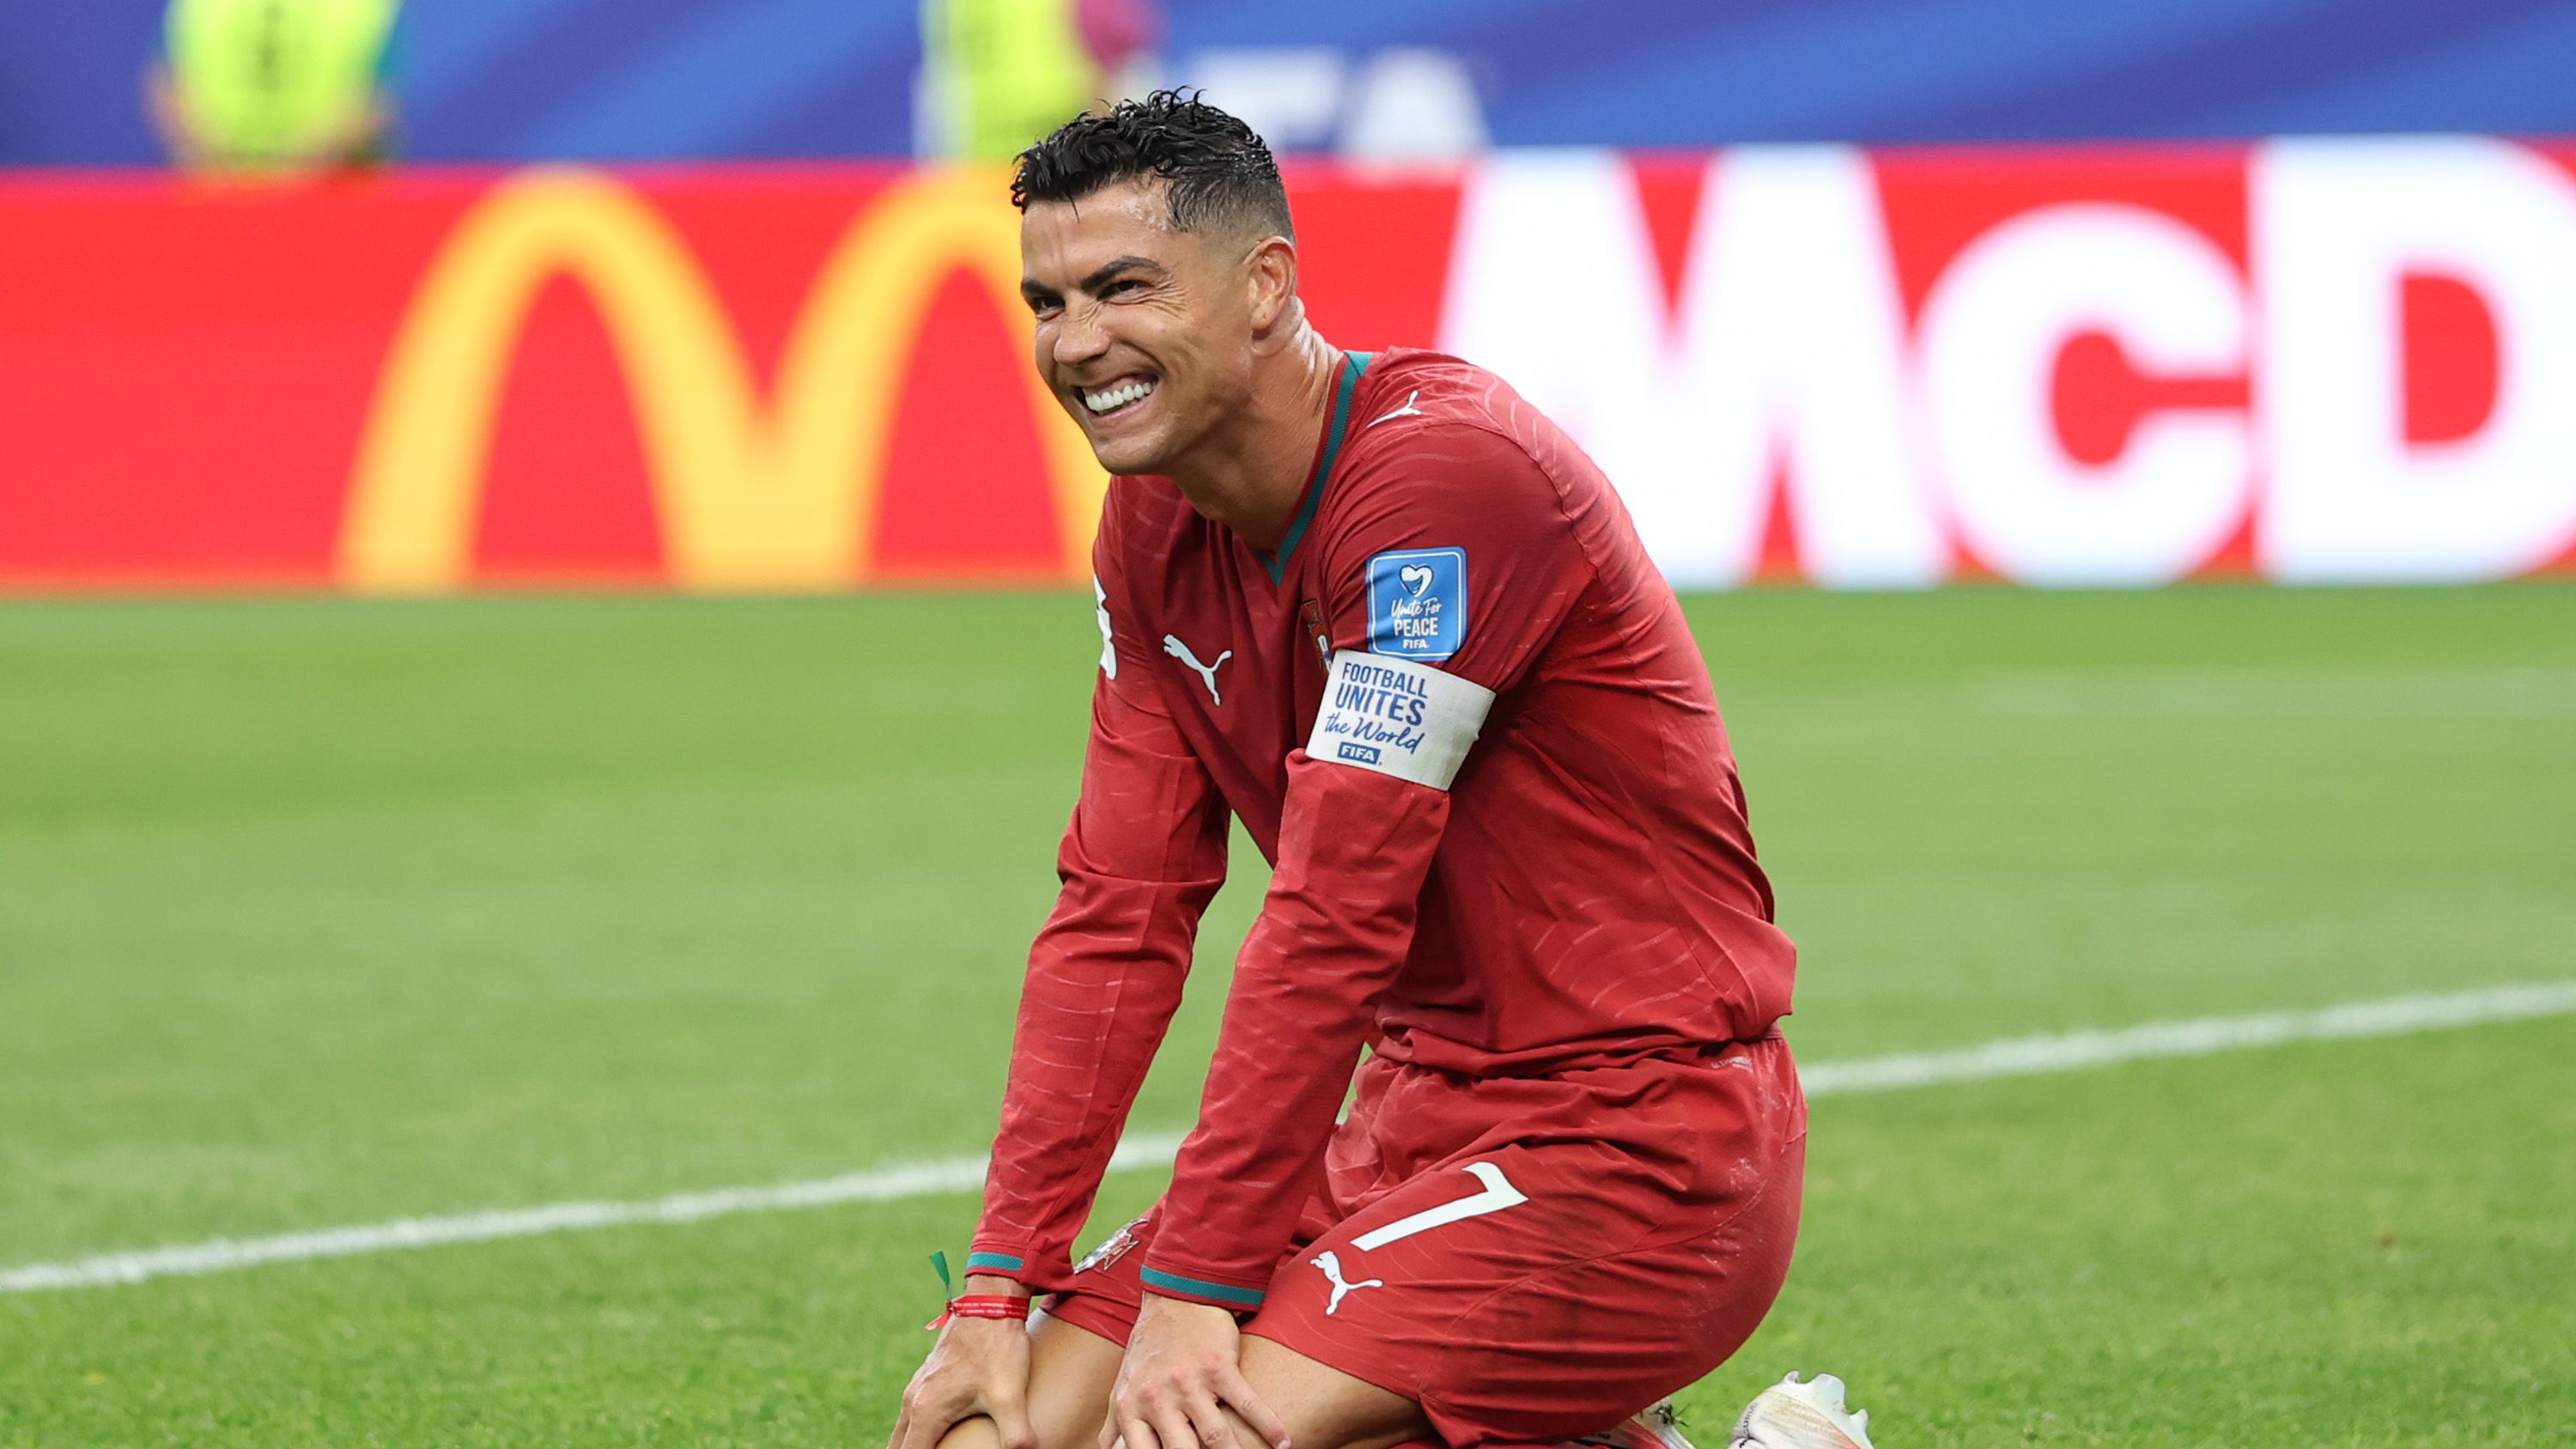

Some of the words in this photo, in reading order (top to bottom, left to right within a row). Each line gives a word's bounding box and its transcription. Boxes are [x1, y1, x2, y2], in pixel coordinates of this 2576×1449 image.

[1391, 597, 1423, 618] Unite
[1423, 597, 1443, 616] For
[1394, 617, 1439, 636] PEACE
[1402, 639, 1429, 650] FIFA
[1342, 662, 1427, 699] FOOTBALL
[1335, 682, 1425, 726] UNITES
[1324, 712, 1351, 734] the
[1352, 717, 1425, 755] World
[1340, 744, 1376, 762] FIFA
[1350, 1161, 1529, 1252] 7
